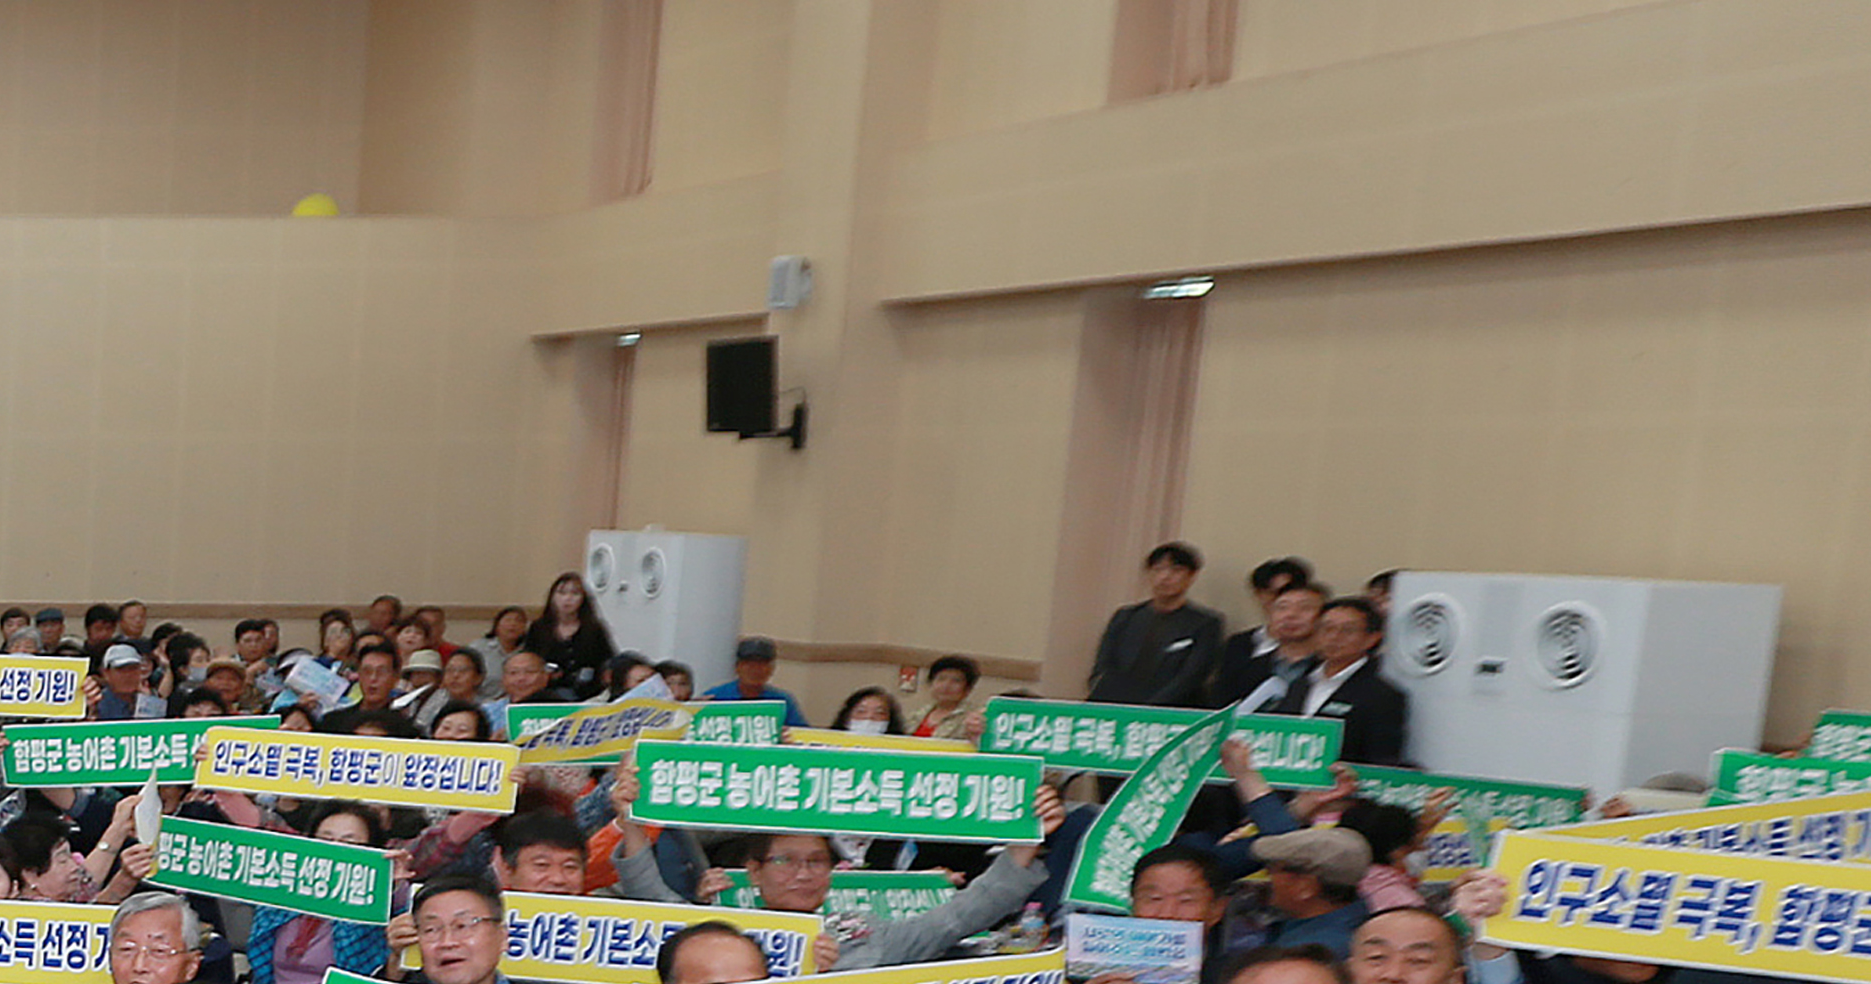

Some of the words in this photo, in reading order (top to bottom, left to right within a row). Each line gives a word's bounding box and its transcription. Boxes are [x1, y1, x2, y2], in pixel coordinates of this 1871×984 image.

[0, 669, 34, 701] 선정
[35, 671, 75, 703] 기원!
[12, 737, 64, 774] 함평군
[65, 735, 116, 772] 농어촌
[120, 732, 190, 771] 기본소득
[993, 711, 1073, 754] 인구소멸
[213, 740, 281, 775] 인구소멸
[284, 748, 324, 786] 극복,
[328, 749, 399, 785] 함평군이
[401, 753, 501, 794] 앞장섭니다!
[650, 759, 723, 807] 함평군
[725, 763, 801, 811] 농어촌
[804, 765, 904, 816] 기본소득
[907, 772, 959, 819] 선정
[961, 774, 1025, 822] 기원!
[187, 837, 235, 878] 농어촌
[236, 845, 299, 892] 기본소득
[298, 856, 332, 896] 선정
[335, 861, 375, 905] 기원!
[1512, 857, 1678, 936] 인구소멸
[1673, 875, 1762, 955] 극복,
[40, 923, 89, 970] 선정
[507, 910, 581, 967] 농어촌
